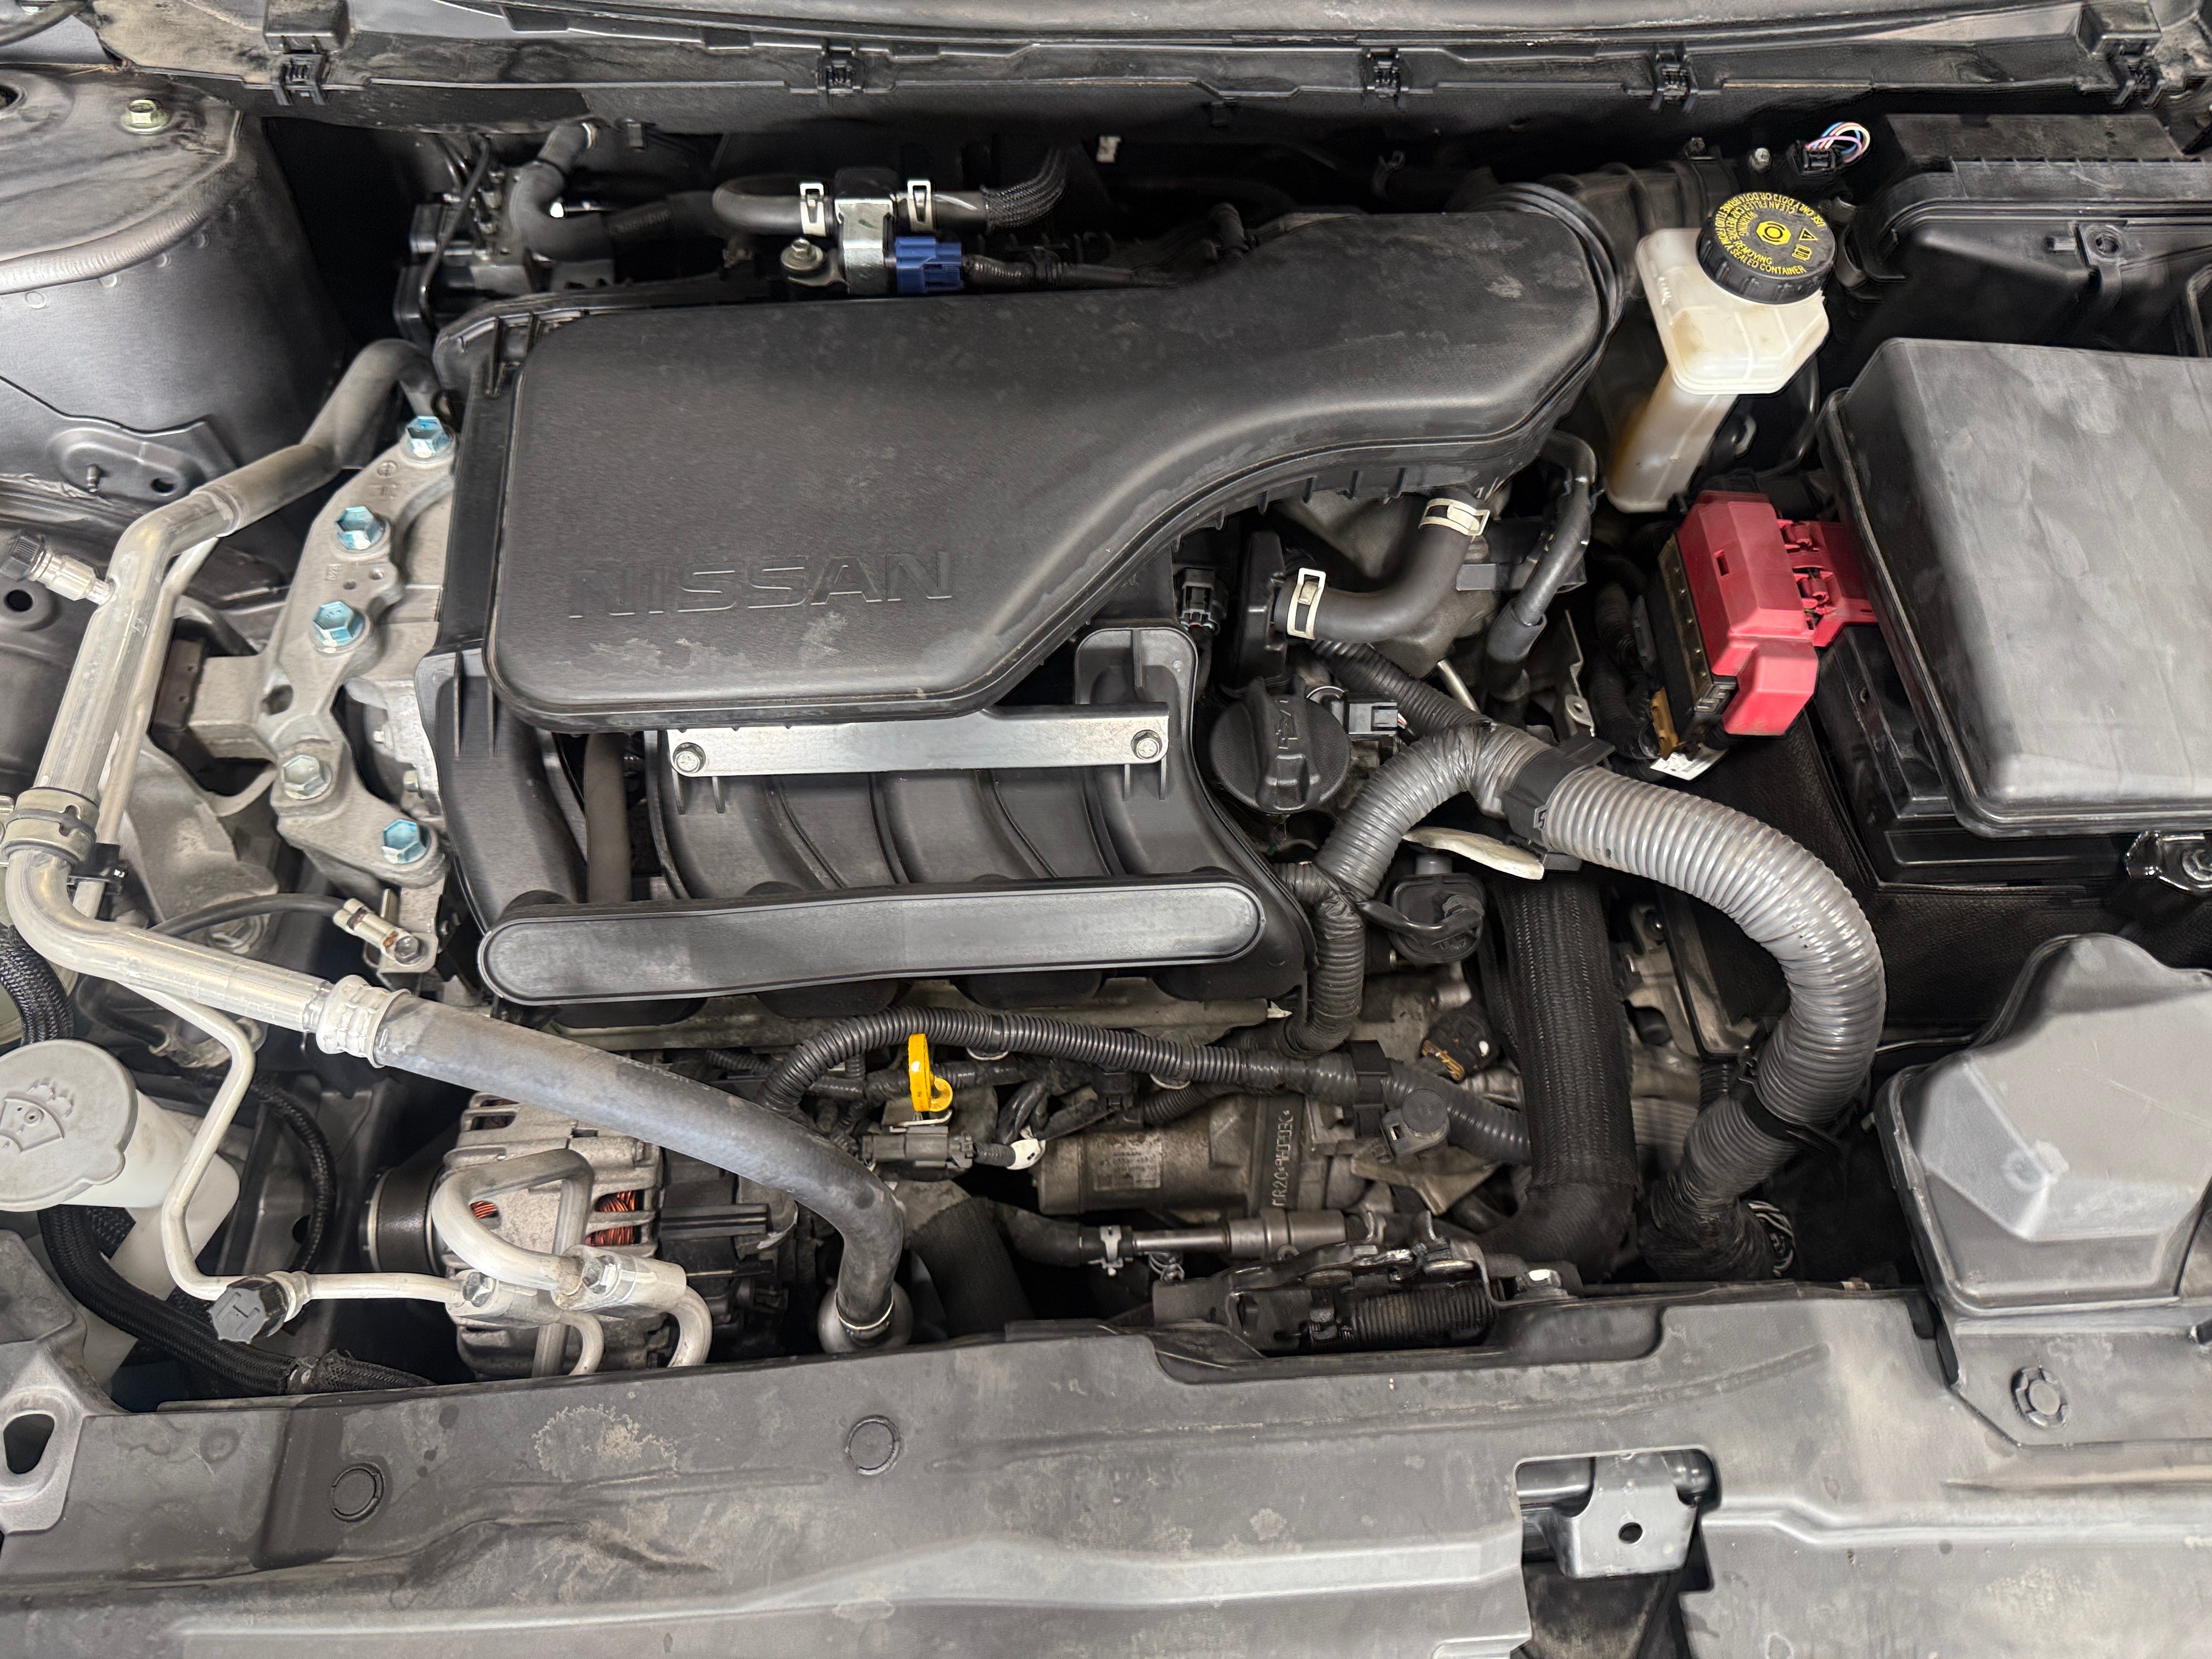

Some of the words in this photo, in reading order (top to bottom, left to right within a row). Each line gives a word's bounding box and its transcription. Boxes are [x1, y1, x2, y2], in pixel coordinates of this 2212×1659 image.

[1720, 198, 1742, 214] BRAKE
[1730, 207, 1745, 219] CAP
[1741, 200, 1768, 211] FILLER
[1769, 201, 1795, 214] CLEAN
[1793, 202, 1814, 216] ONLY
[1715, 211, 1728, 227] FLUID
[1737, 211, 1758, 236] WARNING
[1726, 216, 1740, 240] BEFORE
[1716, 228, 1731, 245] FROM
[1730, 249, 1758, 268] SEALED
[1733, 240, 1772, 264] REMOVING
[1759, 263, 1807, 274] CONTAINER
[568, 551, 952, 618] NISSAN
